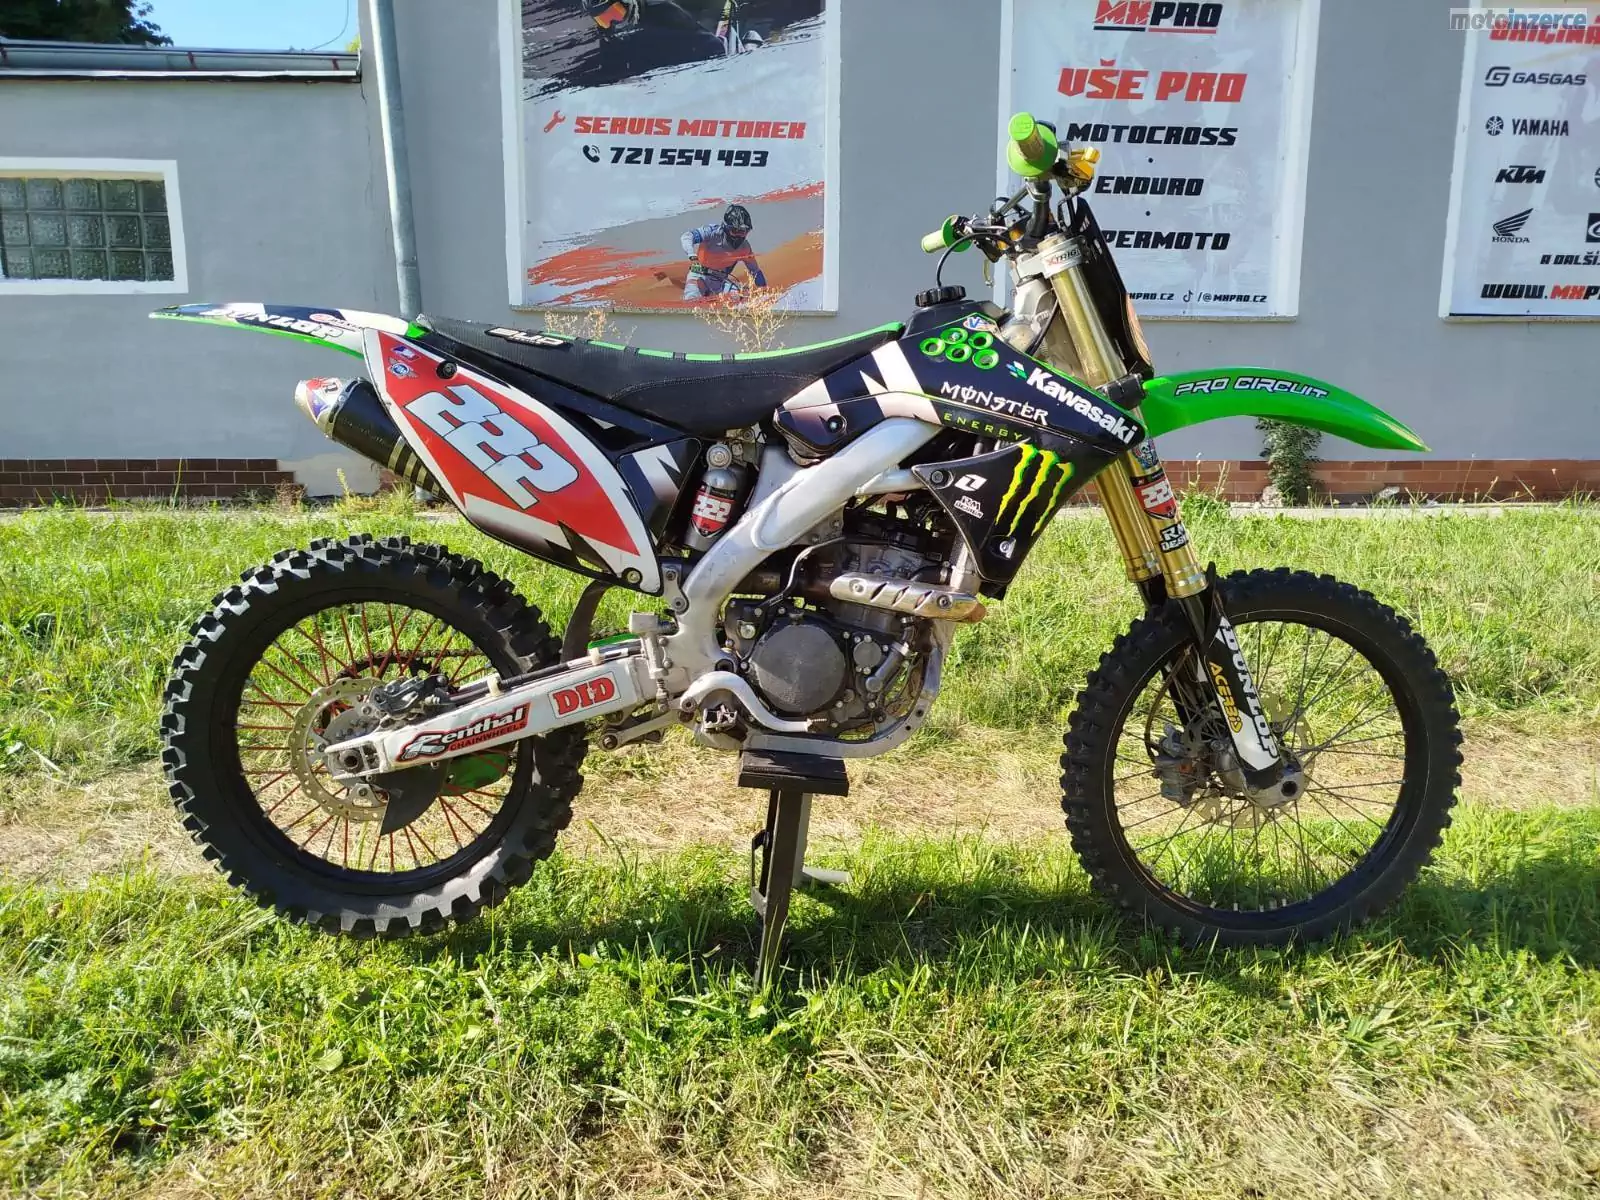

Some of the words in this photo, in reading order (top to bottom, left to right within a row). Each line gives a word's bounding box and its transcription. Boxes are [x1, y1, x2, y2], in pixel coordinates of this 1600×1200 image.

[1094, 0, 1224, 28] MXPRO
[1155, 71, 1248, 103] PRO
[1512, 72, 1587, 86] GASGAS
[573, 116, 673, 137] SERVIS
[676, 118, 807, 140] MOTOREK
[1066, 122, 1238, 146] MOTOCROSS
[1512, 118, 1569, 136] YAMAHA
[610, 147, 655, 165] 721
[658, 148, 711, 167] 554
[716, 150, 769, 168] 493
[1094, 175, 1204, 197] ENDURO
[1494, 165, 1546, 184] KTM
[1101, 230, 1231, 250] PERMOTO
[1492, 236, 1530, 244] HONDA
[1540, 254, 1552, 265] A
[1129, 292, 1174, 301] XPRO.CZ
[1480, 283, 1600, 300] WWW.MXP
[1174, 377, 1230, 397] PRO
[1232, 376, 1329, 399] CIRCUIT
[940, 381, 1049, 427] MONSTER
[1026, 367, 1139, 445] Kawasaki
[943, 412, 1023, 440] ENERGY
[403, 384, 580, 511] 222
[692, 493, 733, 524] 222
[1220, 626, 1280, 759] DUNLOP
[399, 707, 526, 759] Renthal
[450, 721, 526, 751] CHAINWHEELS
